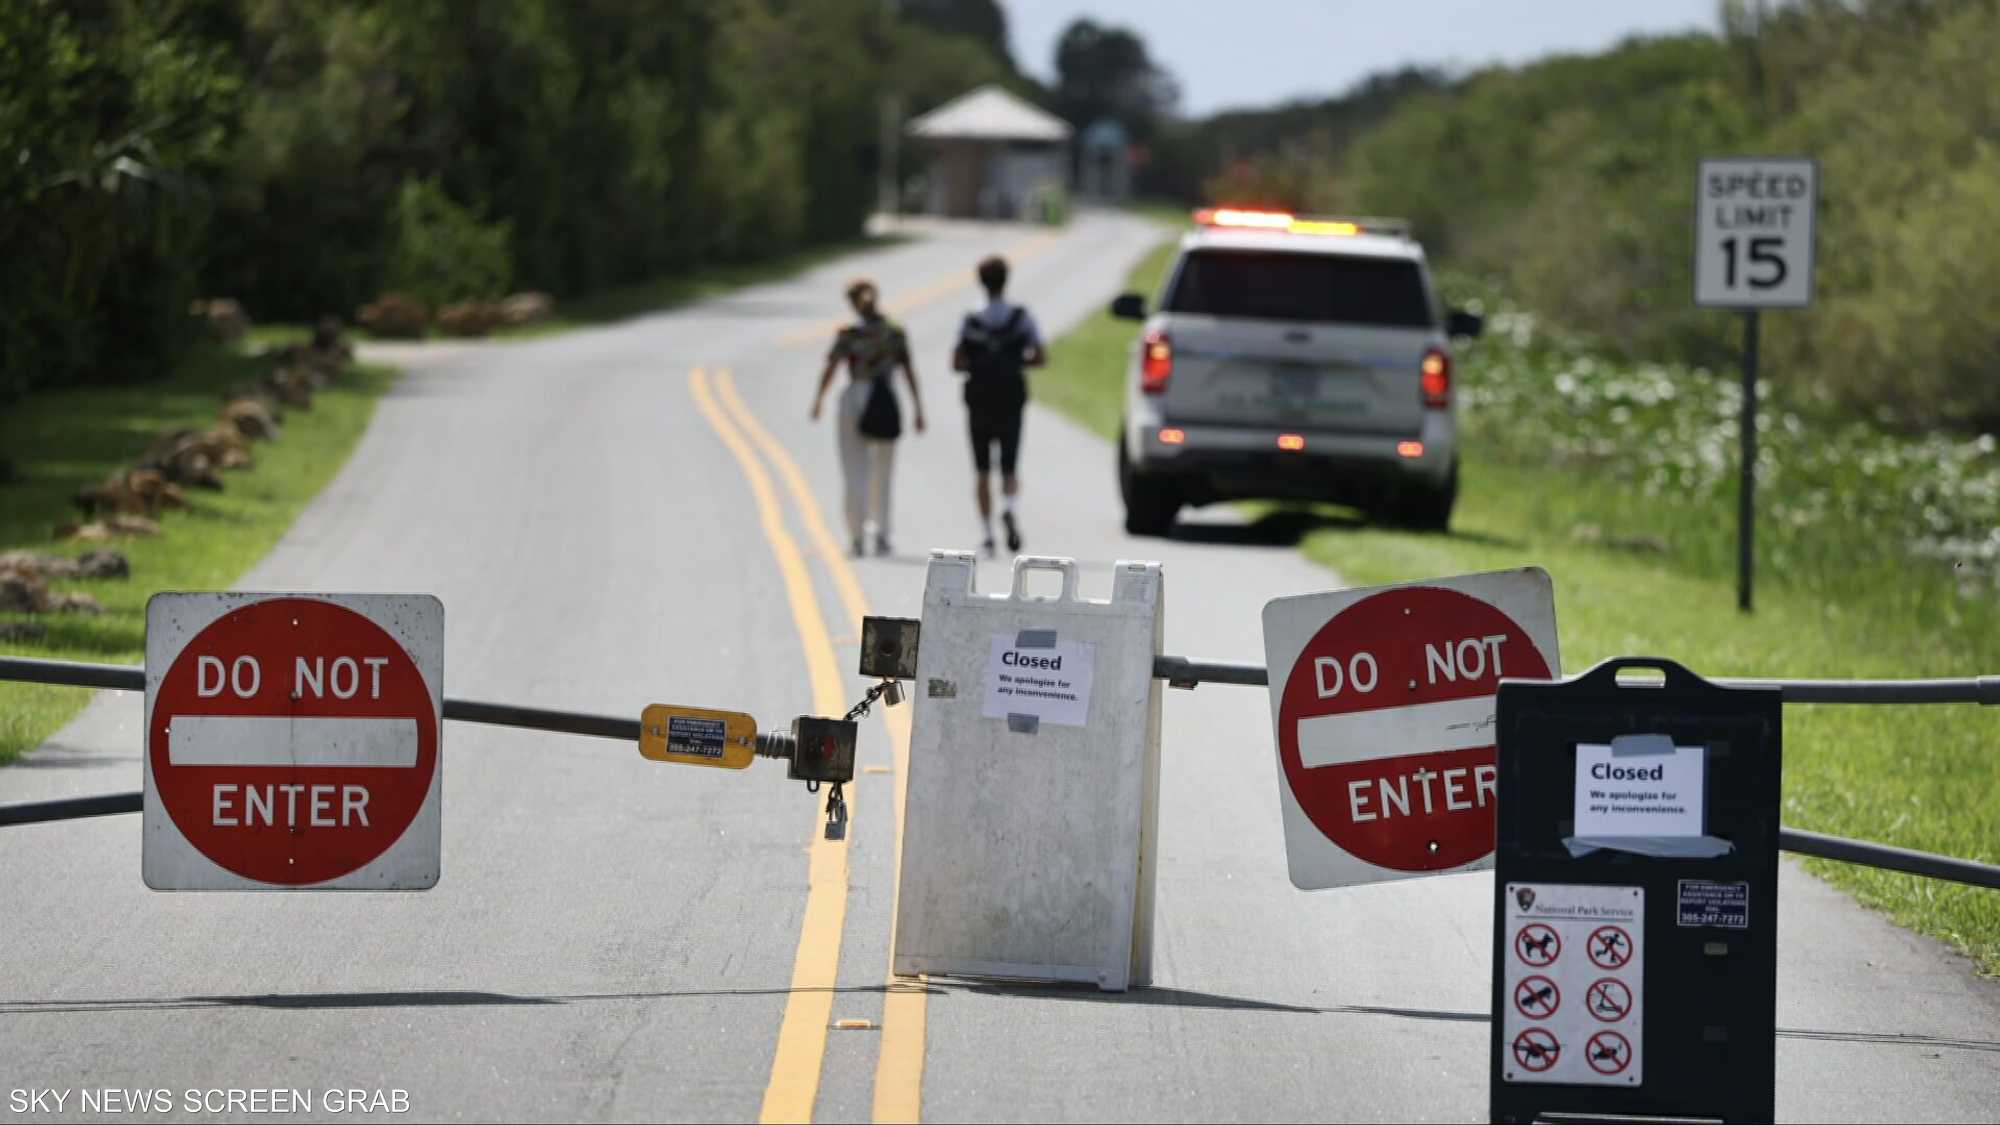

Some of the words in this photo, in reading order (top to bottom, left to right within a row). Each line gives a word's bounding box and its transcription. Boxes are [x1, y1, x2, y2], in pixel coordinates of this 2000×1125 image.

[1707, 172, 1806, 199] SPEED
[1715, 205, 1793, 229] LIMIT
[1720, 237, 1787, 288] 15
[1001, 651, 1062, 671] Closed
[1314, 651, 1378, 700] DO
[1424, 634, 1508, 685] NOT
[197, 655, 261, 698] DO
[294, 656, 389, 699] NOT
[999, 673, 1012, 682] We
[1014, 677, 1056, 688] apologize
[1058, 680, 1071, 688] for
[997, 686, 1013, 697] any
[1591, 762, 1664, 781] Closed
[1348, 767, 1497, 822] ENTER
[1590, 789, 1606, 799] We
[1608, 790, 1658, 802] apologize
[1661, 791, 1677, 800] for
[213, 784, 370, 827] ENTER
[1589, 804, 1608, 815] any
[1611, 803, 1687, 815] inconvenience.
[1535, 904, 1575, 915] National
[1577, 906, 1598, 916] Park
[1601, 908, 1634, 917] Service
[1681, 913, 1745, 924] 305-247-7272
